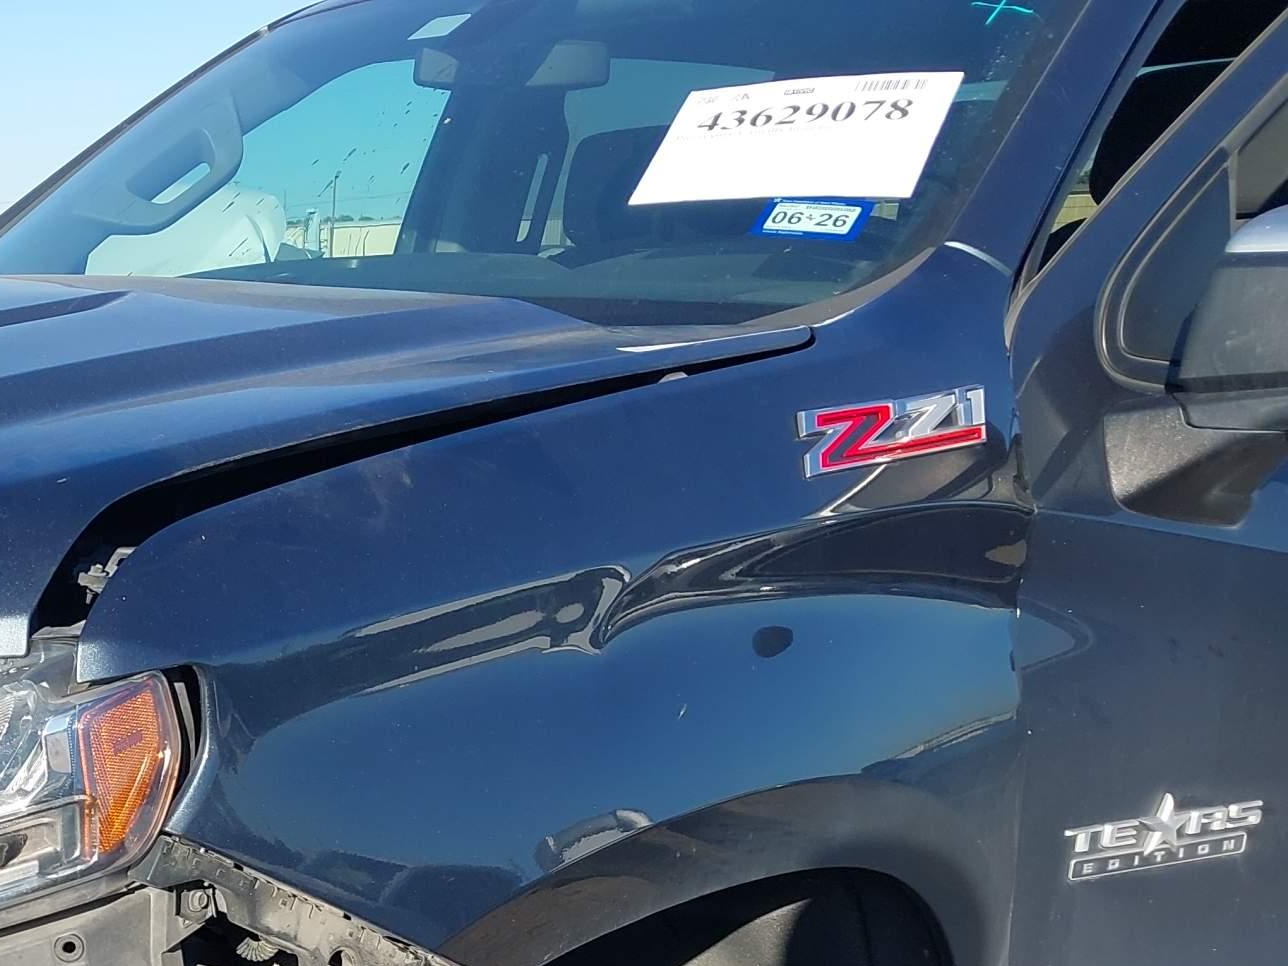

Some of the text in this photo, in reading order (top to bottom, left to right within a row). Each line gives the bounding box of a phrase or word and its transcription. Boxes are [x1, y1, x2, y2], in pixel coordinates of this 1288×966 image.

[697, 97, 914, 132] 43629078
[794, 384, 987, 479] Z71
[1082, 839, 1236, 875] EDITION
